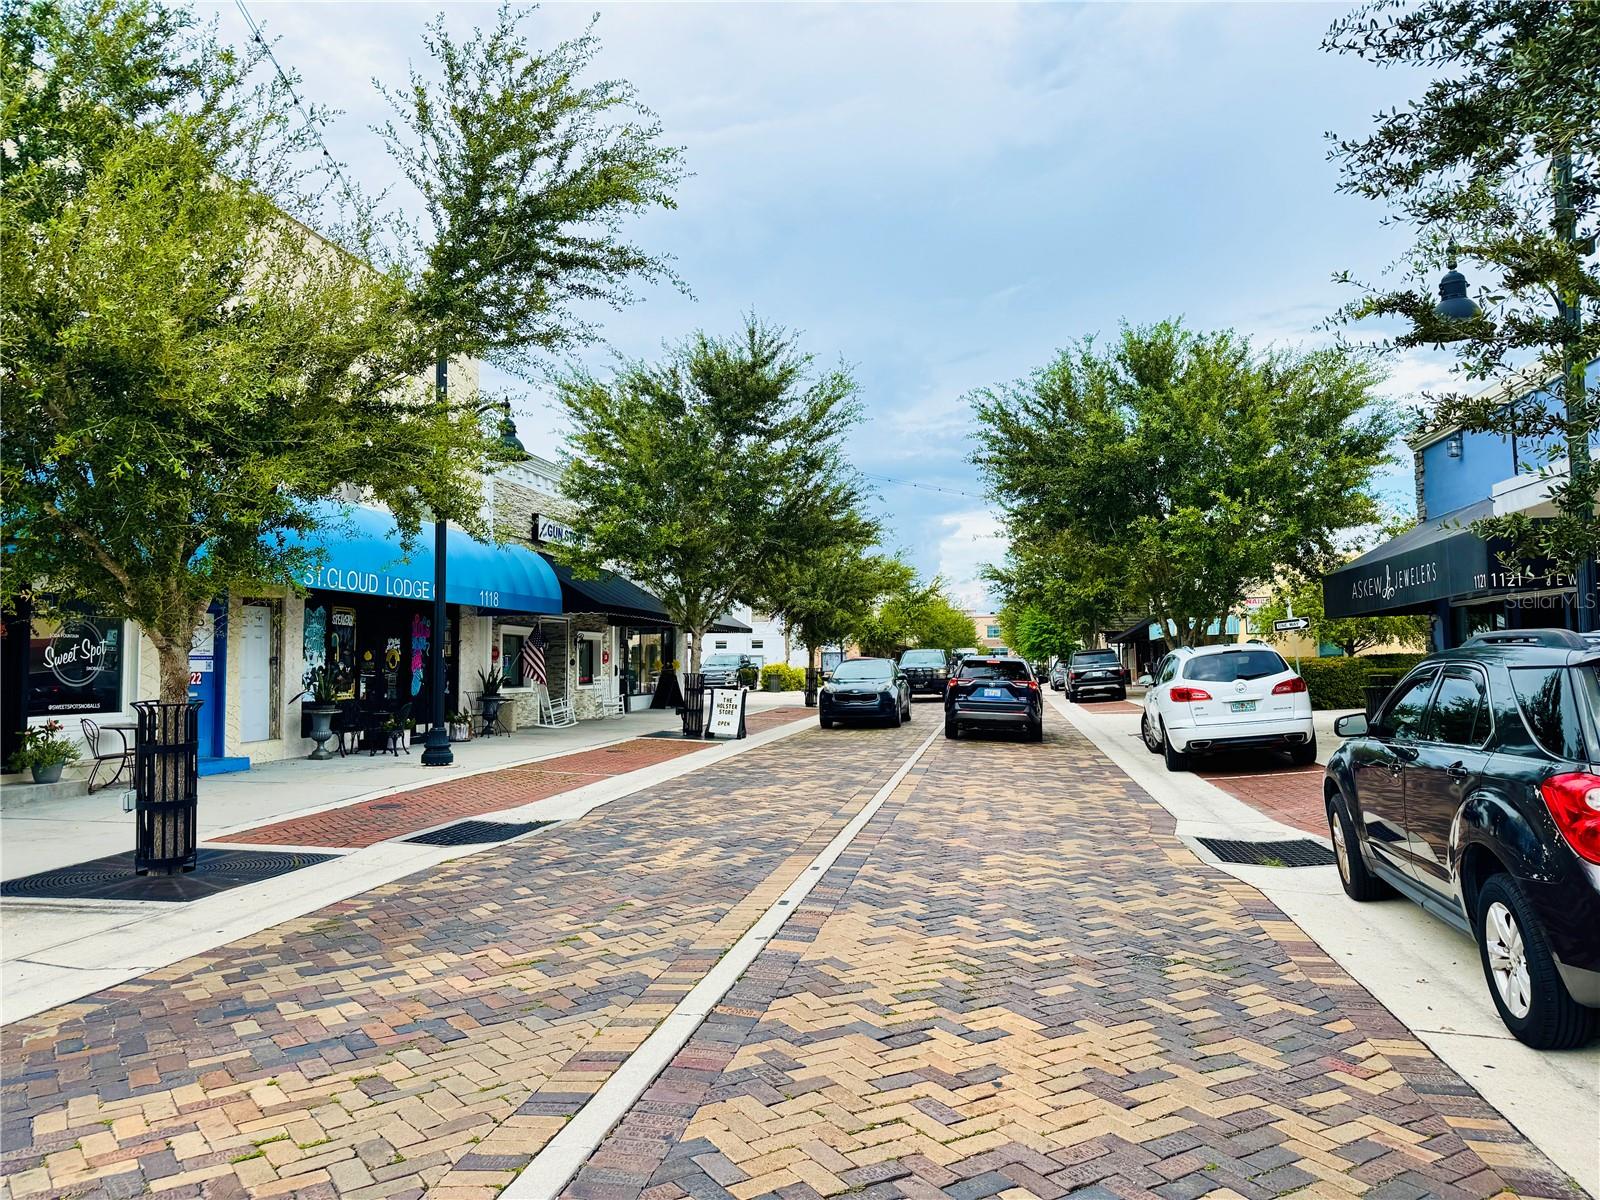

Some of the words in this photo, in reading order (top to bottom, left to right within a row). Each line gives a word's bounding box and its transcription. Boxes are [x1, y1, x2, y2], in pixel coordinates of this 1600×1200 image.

[548, 524, 564, 540] GUN
[303, 565, 379, 593] ST.CLOUD
[386, 576, 430, 599] LODGE
[1352, 576, 1382, 599] ASKEW
[1395, 562, 1437, 589] JEWELERS
[1474, 573, 1487, 589] 1121
[1491, 572, 1522, 587] 1121
[479, 590, 500, 607] 1118
[43, 643, 80, 668] Sweet
[80, 638, 109, 663] Spot
